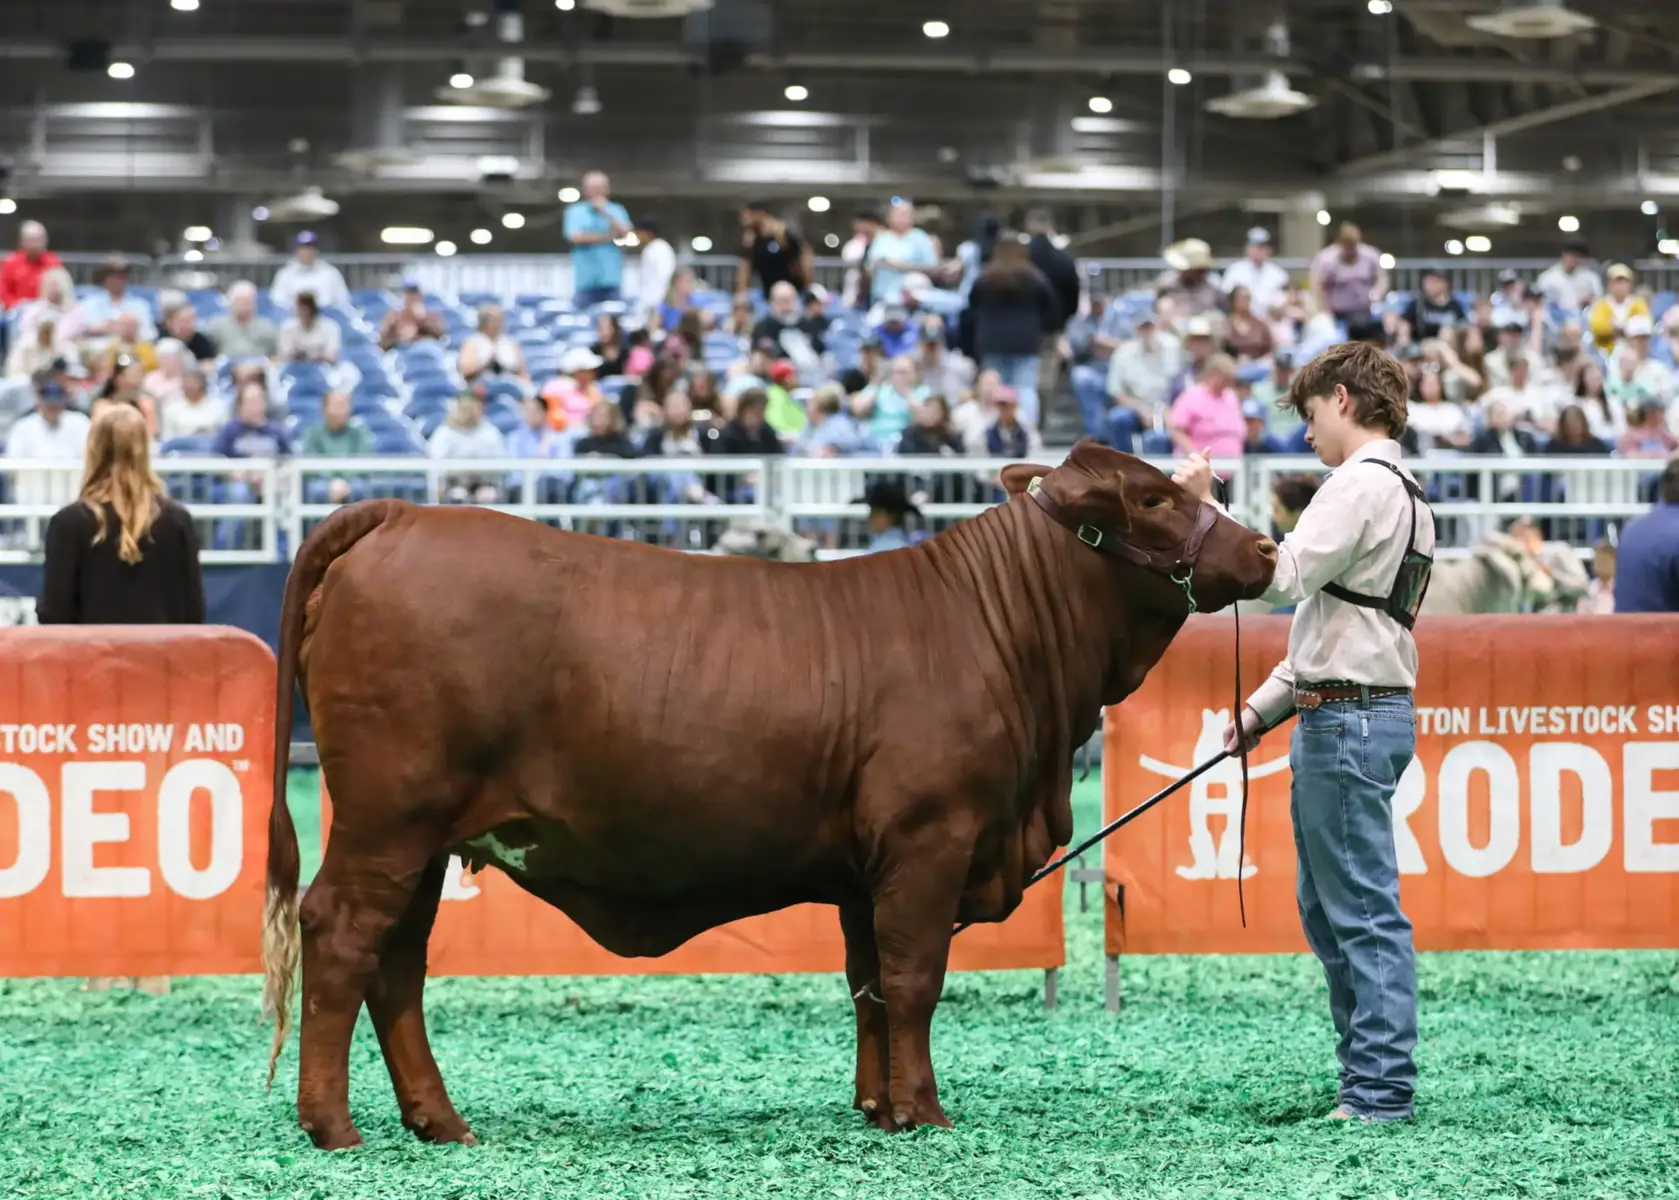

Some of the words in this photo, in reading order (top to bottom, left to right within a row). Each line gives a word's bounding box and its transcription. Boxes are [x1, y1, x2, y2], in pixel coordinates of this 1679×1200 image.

[1415, 706, 1471, 735] TON
[1478, 704, 1639, 735] LIVESTOCK
[1647, 703, 1679, 734] SH
[87, 723, 174, 753] SHOW
[184, 723, 244, 753] AND
[0, 758, 244, 901] DEO
